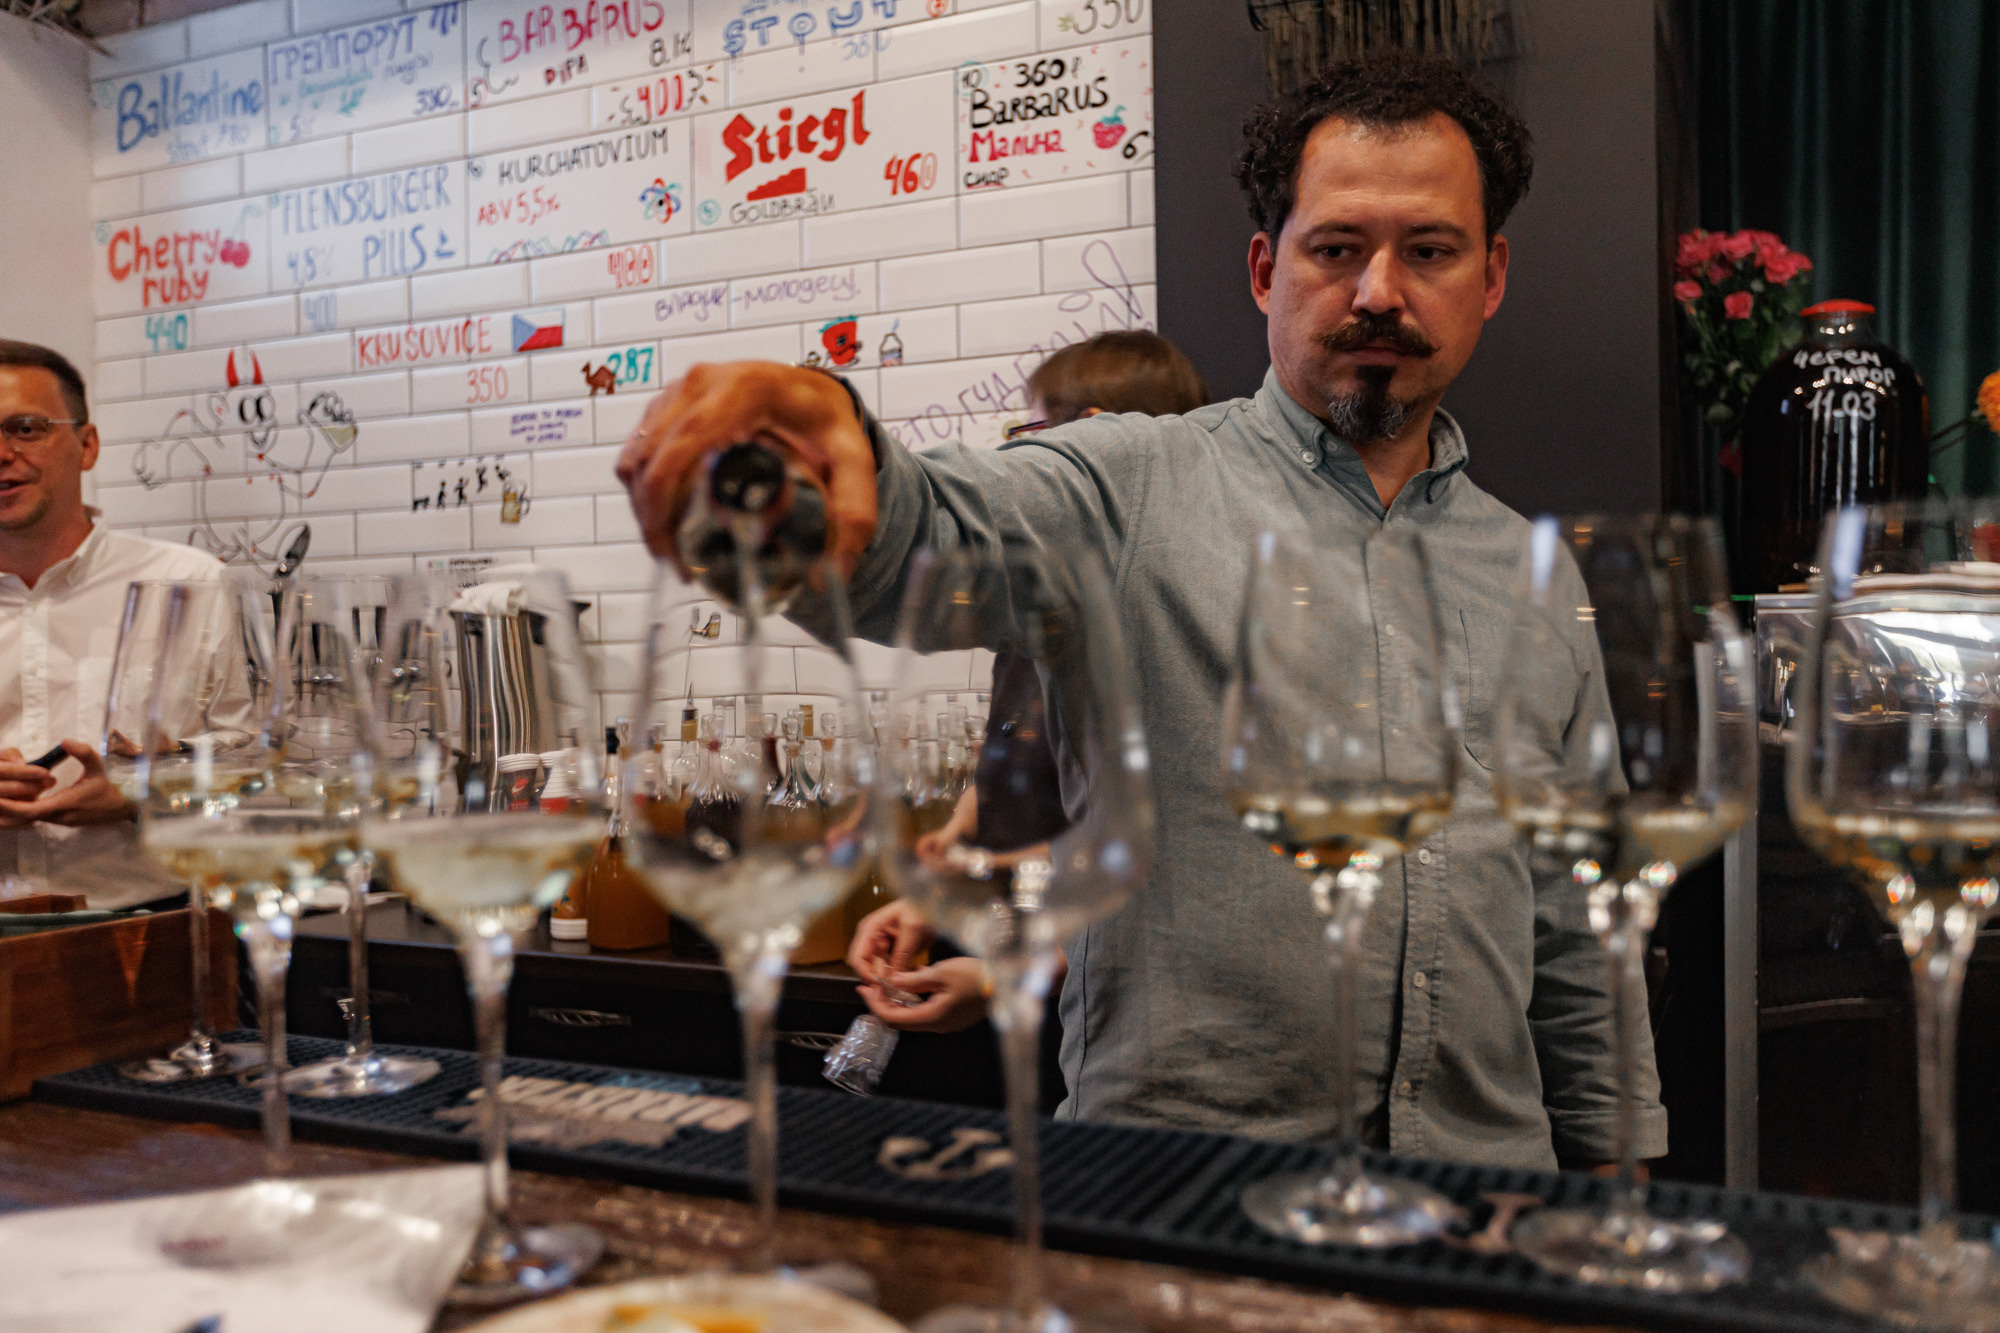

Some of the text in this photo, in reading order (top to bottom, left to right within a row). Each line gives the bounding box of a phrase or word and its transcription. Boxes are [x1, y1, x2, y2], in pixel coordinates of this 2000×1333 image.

[499, 0, 665, 63] BARBARUS
[498, 127, 669, 185] KURCHATOVIUM
[722, 89, 871, 184] Stiegl
[884, 152, 938, 196] 460
[107, 224, 220, 283] Cherry
[142, 262, 209, 308] ruby
[145, 312, 188, 354] 440
[466, 365, 510, 404] 350
